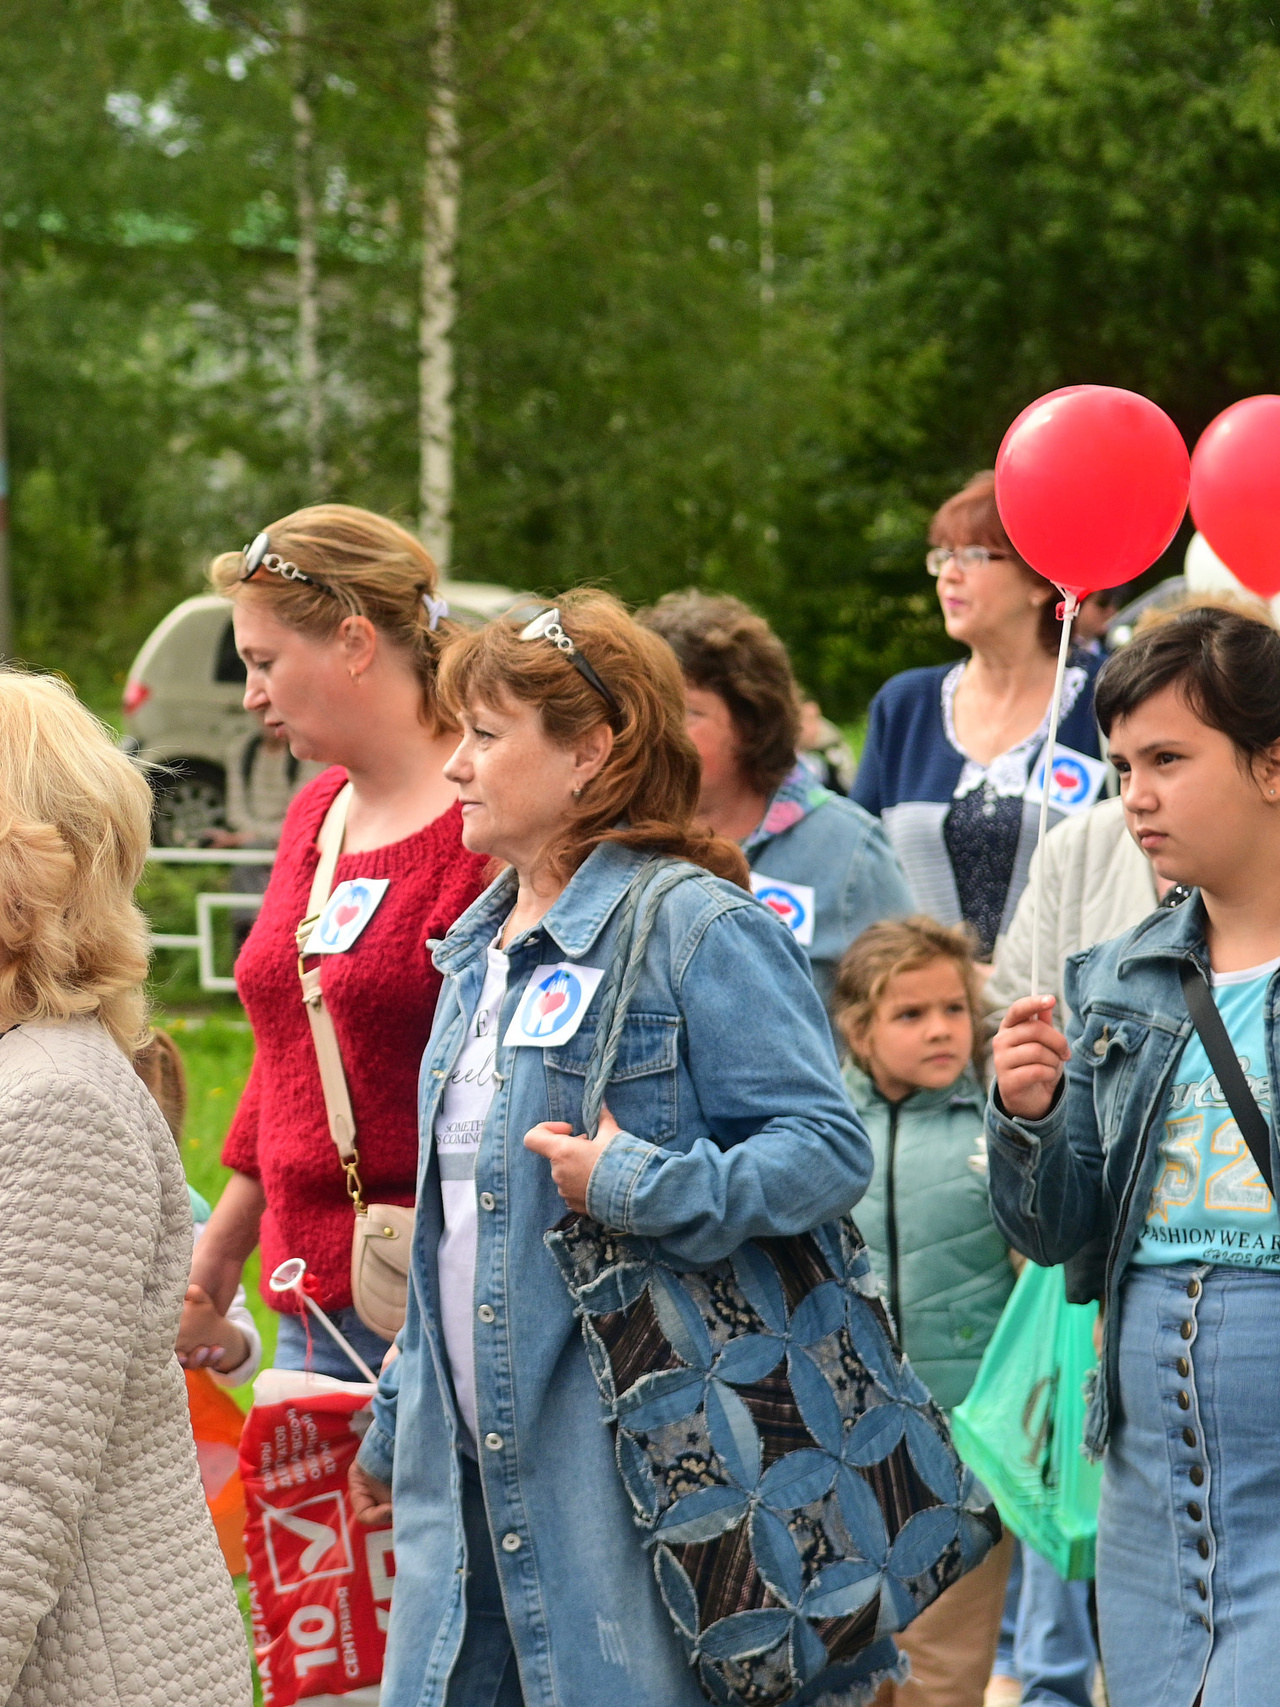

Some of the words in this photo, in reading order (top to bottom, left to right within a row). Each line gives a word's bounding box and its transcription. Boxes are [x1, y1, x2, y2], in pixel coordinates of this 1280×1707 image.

[1154, 1114, 1272, 1214] 52
[1140, 1224, 1216, 1244] FASHION
[288, 1604, 339, 1678] 10
[336, 1586, 360, 1678] СЕНТЯБРЯ
